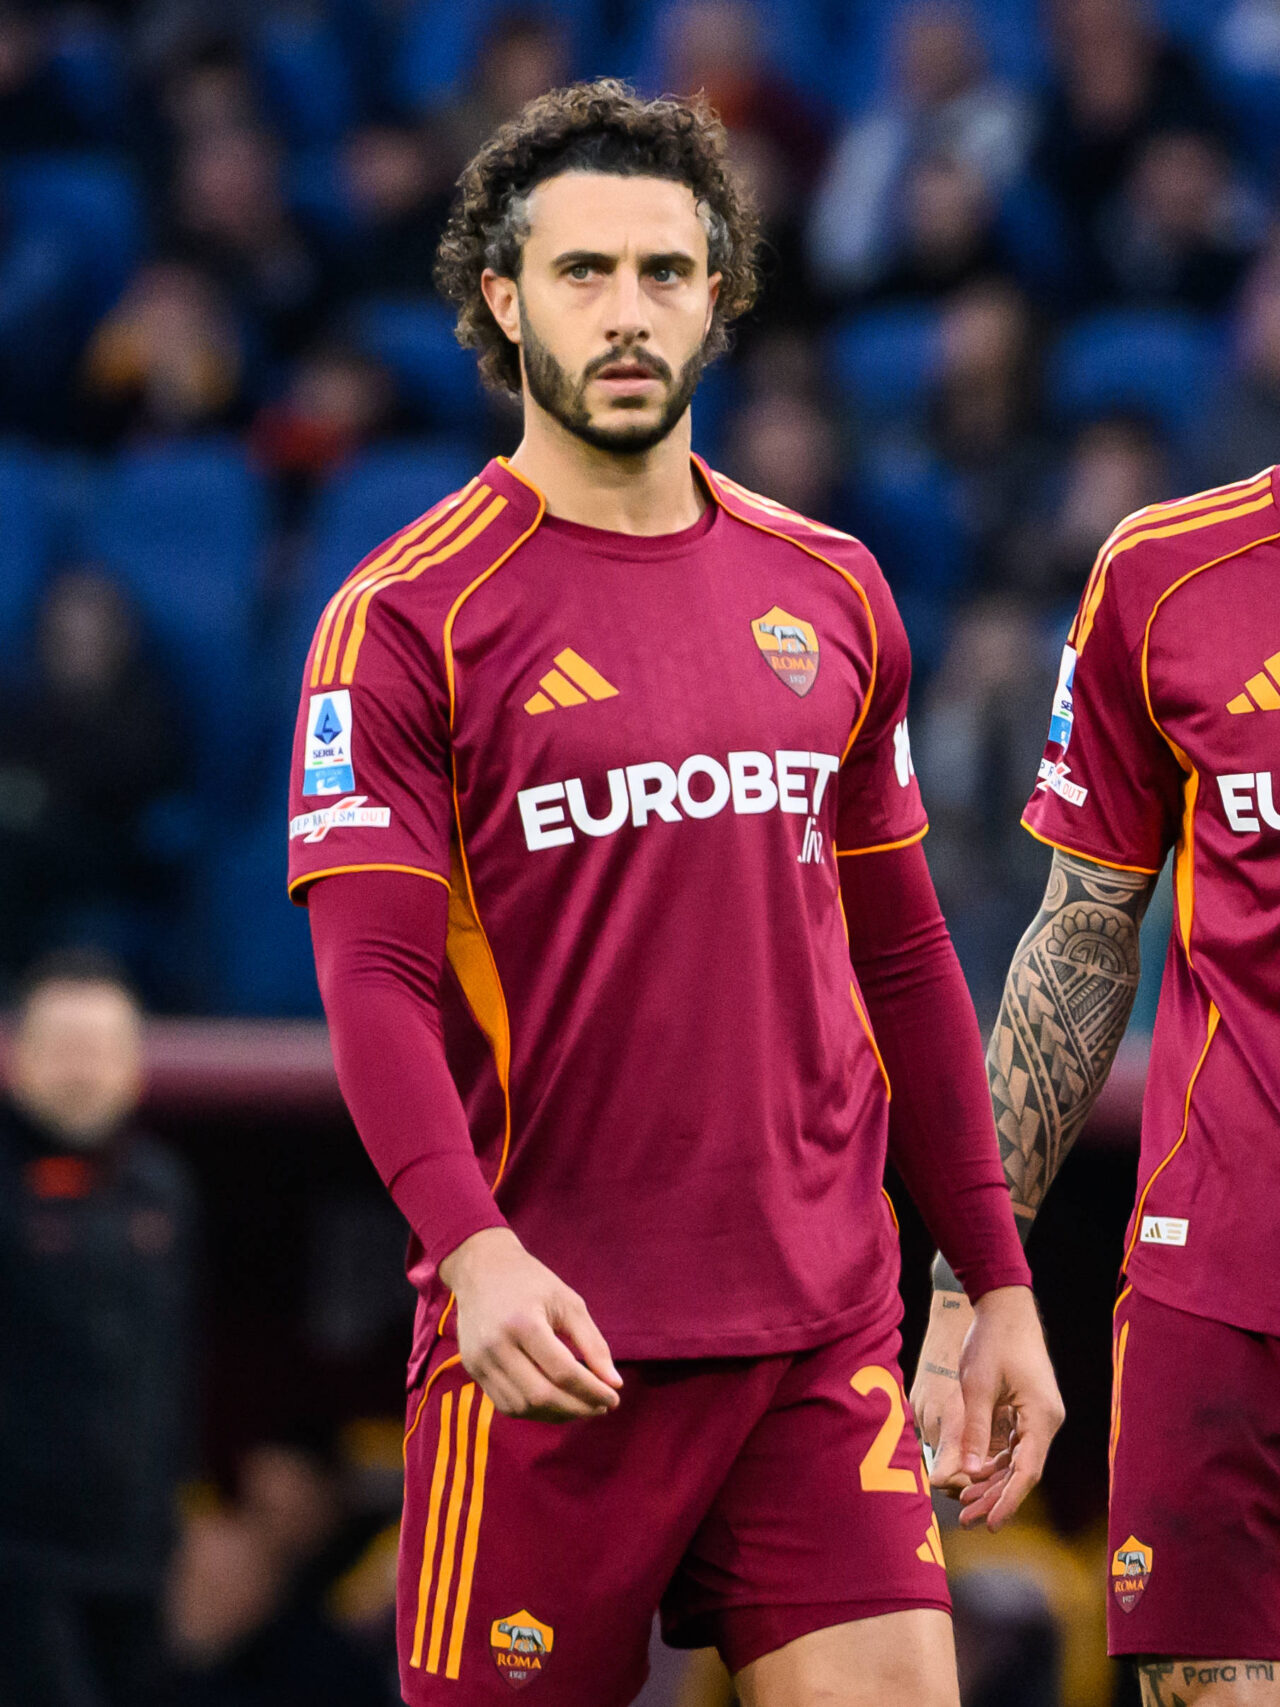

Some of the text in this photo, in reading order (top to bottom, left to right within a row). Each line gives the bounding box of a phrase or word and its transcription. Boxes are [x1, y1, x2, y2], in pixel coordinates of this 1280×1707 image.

[771, 655, 816, 671] ROMA
[313, 747, 344, 759] SERIE A
[1062, 782, 1084, 802] OUT
[517, 750, 840, 852] EUROBET
[361, 811, 386, 823] OUT
[1115, 1579, 1145, 1594] ROMA
[497, 1653, 542, 1670] ROMA
[1182, 1665, 1237, 1686] Para
